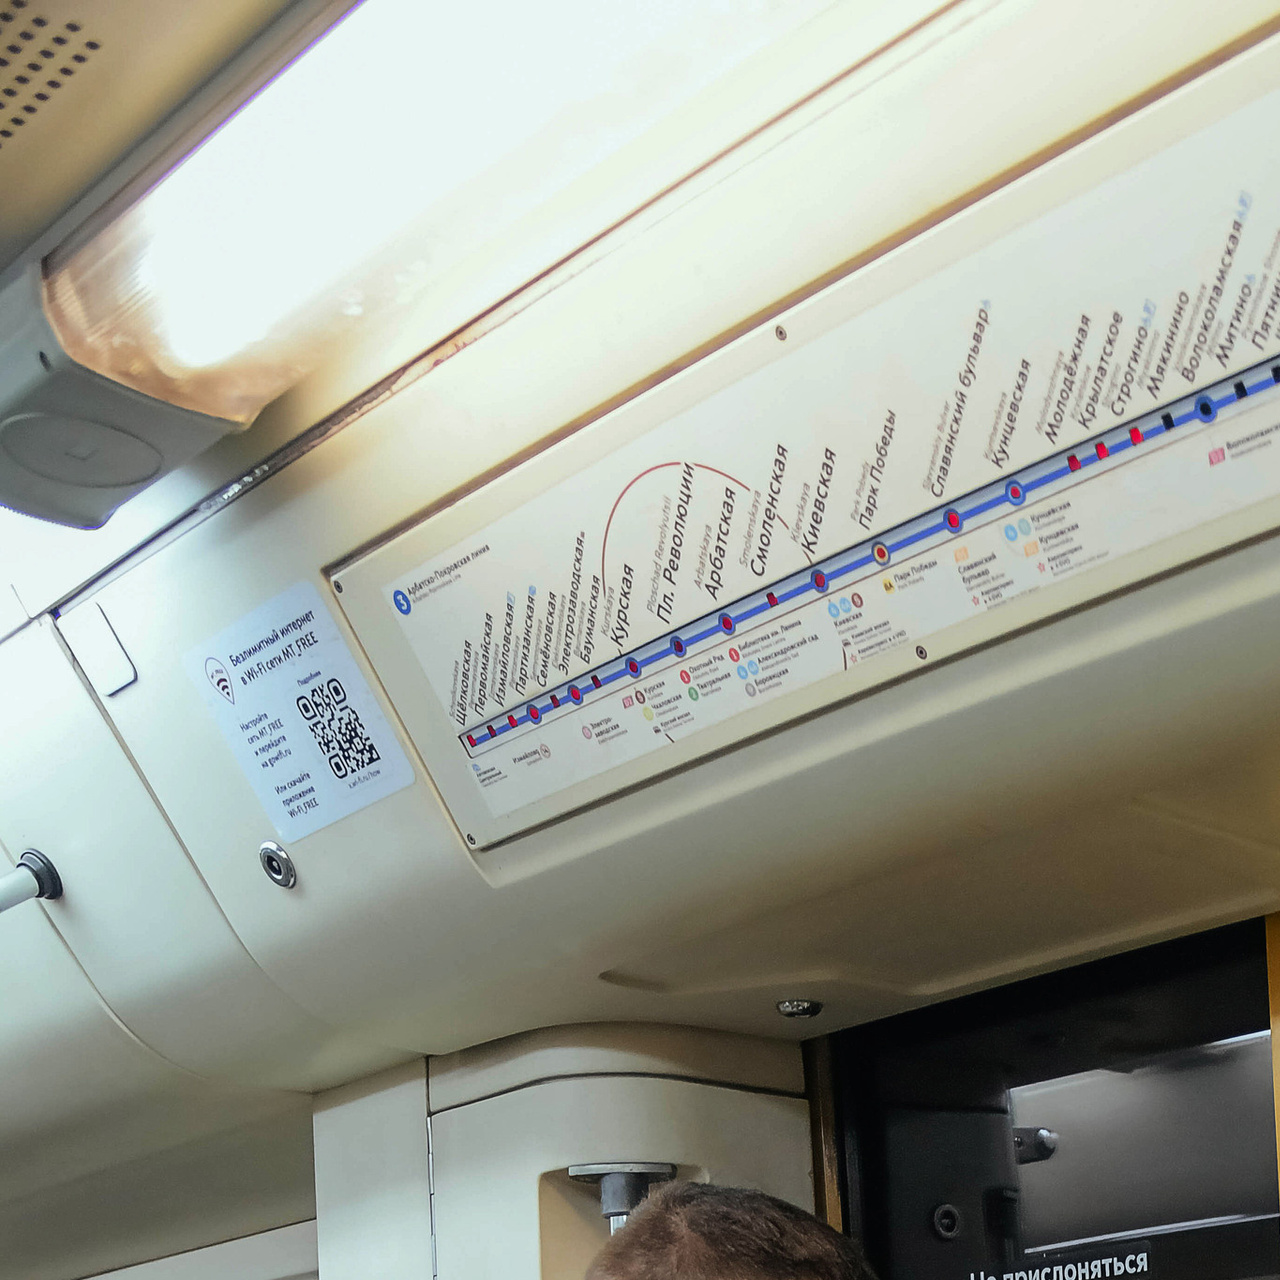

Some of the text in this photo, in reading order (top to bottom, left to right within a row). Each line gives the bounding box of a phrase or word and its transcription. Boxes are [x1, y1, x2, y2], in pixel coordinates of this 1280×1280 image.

[1146, 291, 1189, 400] Мякинино
[1181, 219, 1243, 383] Волоколамская
[1216, 283, 1252, 369] Митино
[931, 390, 967, 498] Славянский
[959, 308, 989, 388] бульвар
[991, 358, 1032, 469] Кунцевская
[1045, 314, 1092, 445] Молодёжная
[1078, 311, 1124, 430] Крылатское
[1111, 326, 1148, 417] Строгино
[751, 444, 788, 577] Смоленская
[801, 447, 837, 555] Киевская
[859, 409, 897, 531] Парк Победы
[656, 462, 695, 624] Пл. Революции
[705, 487, 736, 601] Арбатская
[229, 610, 315, 667] Безлимитный интернет
[244, 661, 268, 682] Wi-Fi
[266, 655, 283, 671] сети
[281, 631, 319, 662] MT_FREE
[495, 602, 514, 707] Измайловская
[515, 595, 535, 696] Партизанская
[536, 591, 557, 687] Семёновская
[559, 536, 584, 676] Электрозаводская
[580, 575, 600, 664] Бауманская
[611, 563, 634, 647] Курская
[456, 640, 472, 726] Щёлковская
[474, 613, 493, 717] Первомайская
